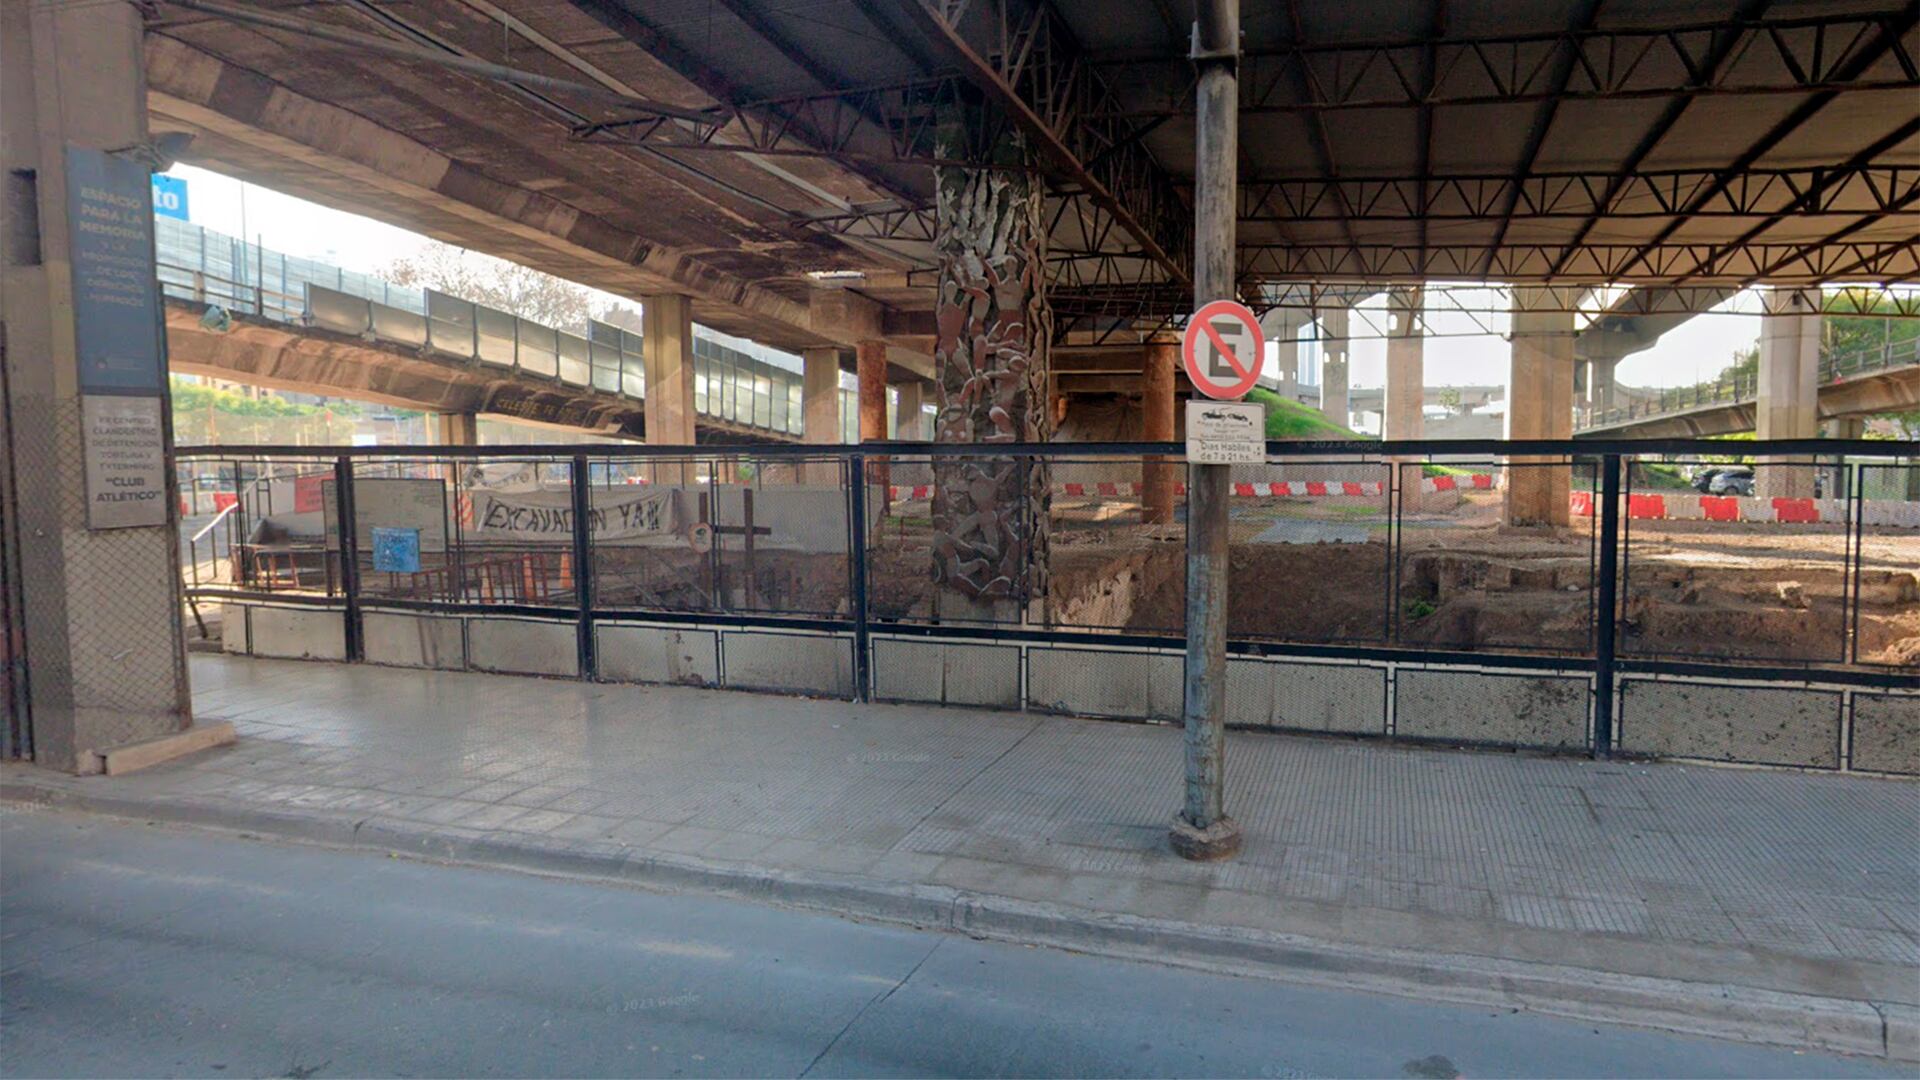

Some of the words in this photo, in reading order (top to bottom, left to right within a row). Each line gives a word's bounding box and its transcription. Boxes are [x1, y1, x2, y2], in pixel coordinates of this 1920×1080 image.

[81, 187, 142, 209] ESPACIO
[81, 203, 120, 222] PARA
[79, 220, 147, 241] MEMORIA
[1210, 322, 1242, 377] E
